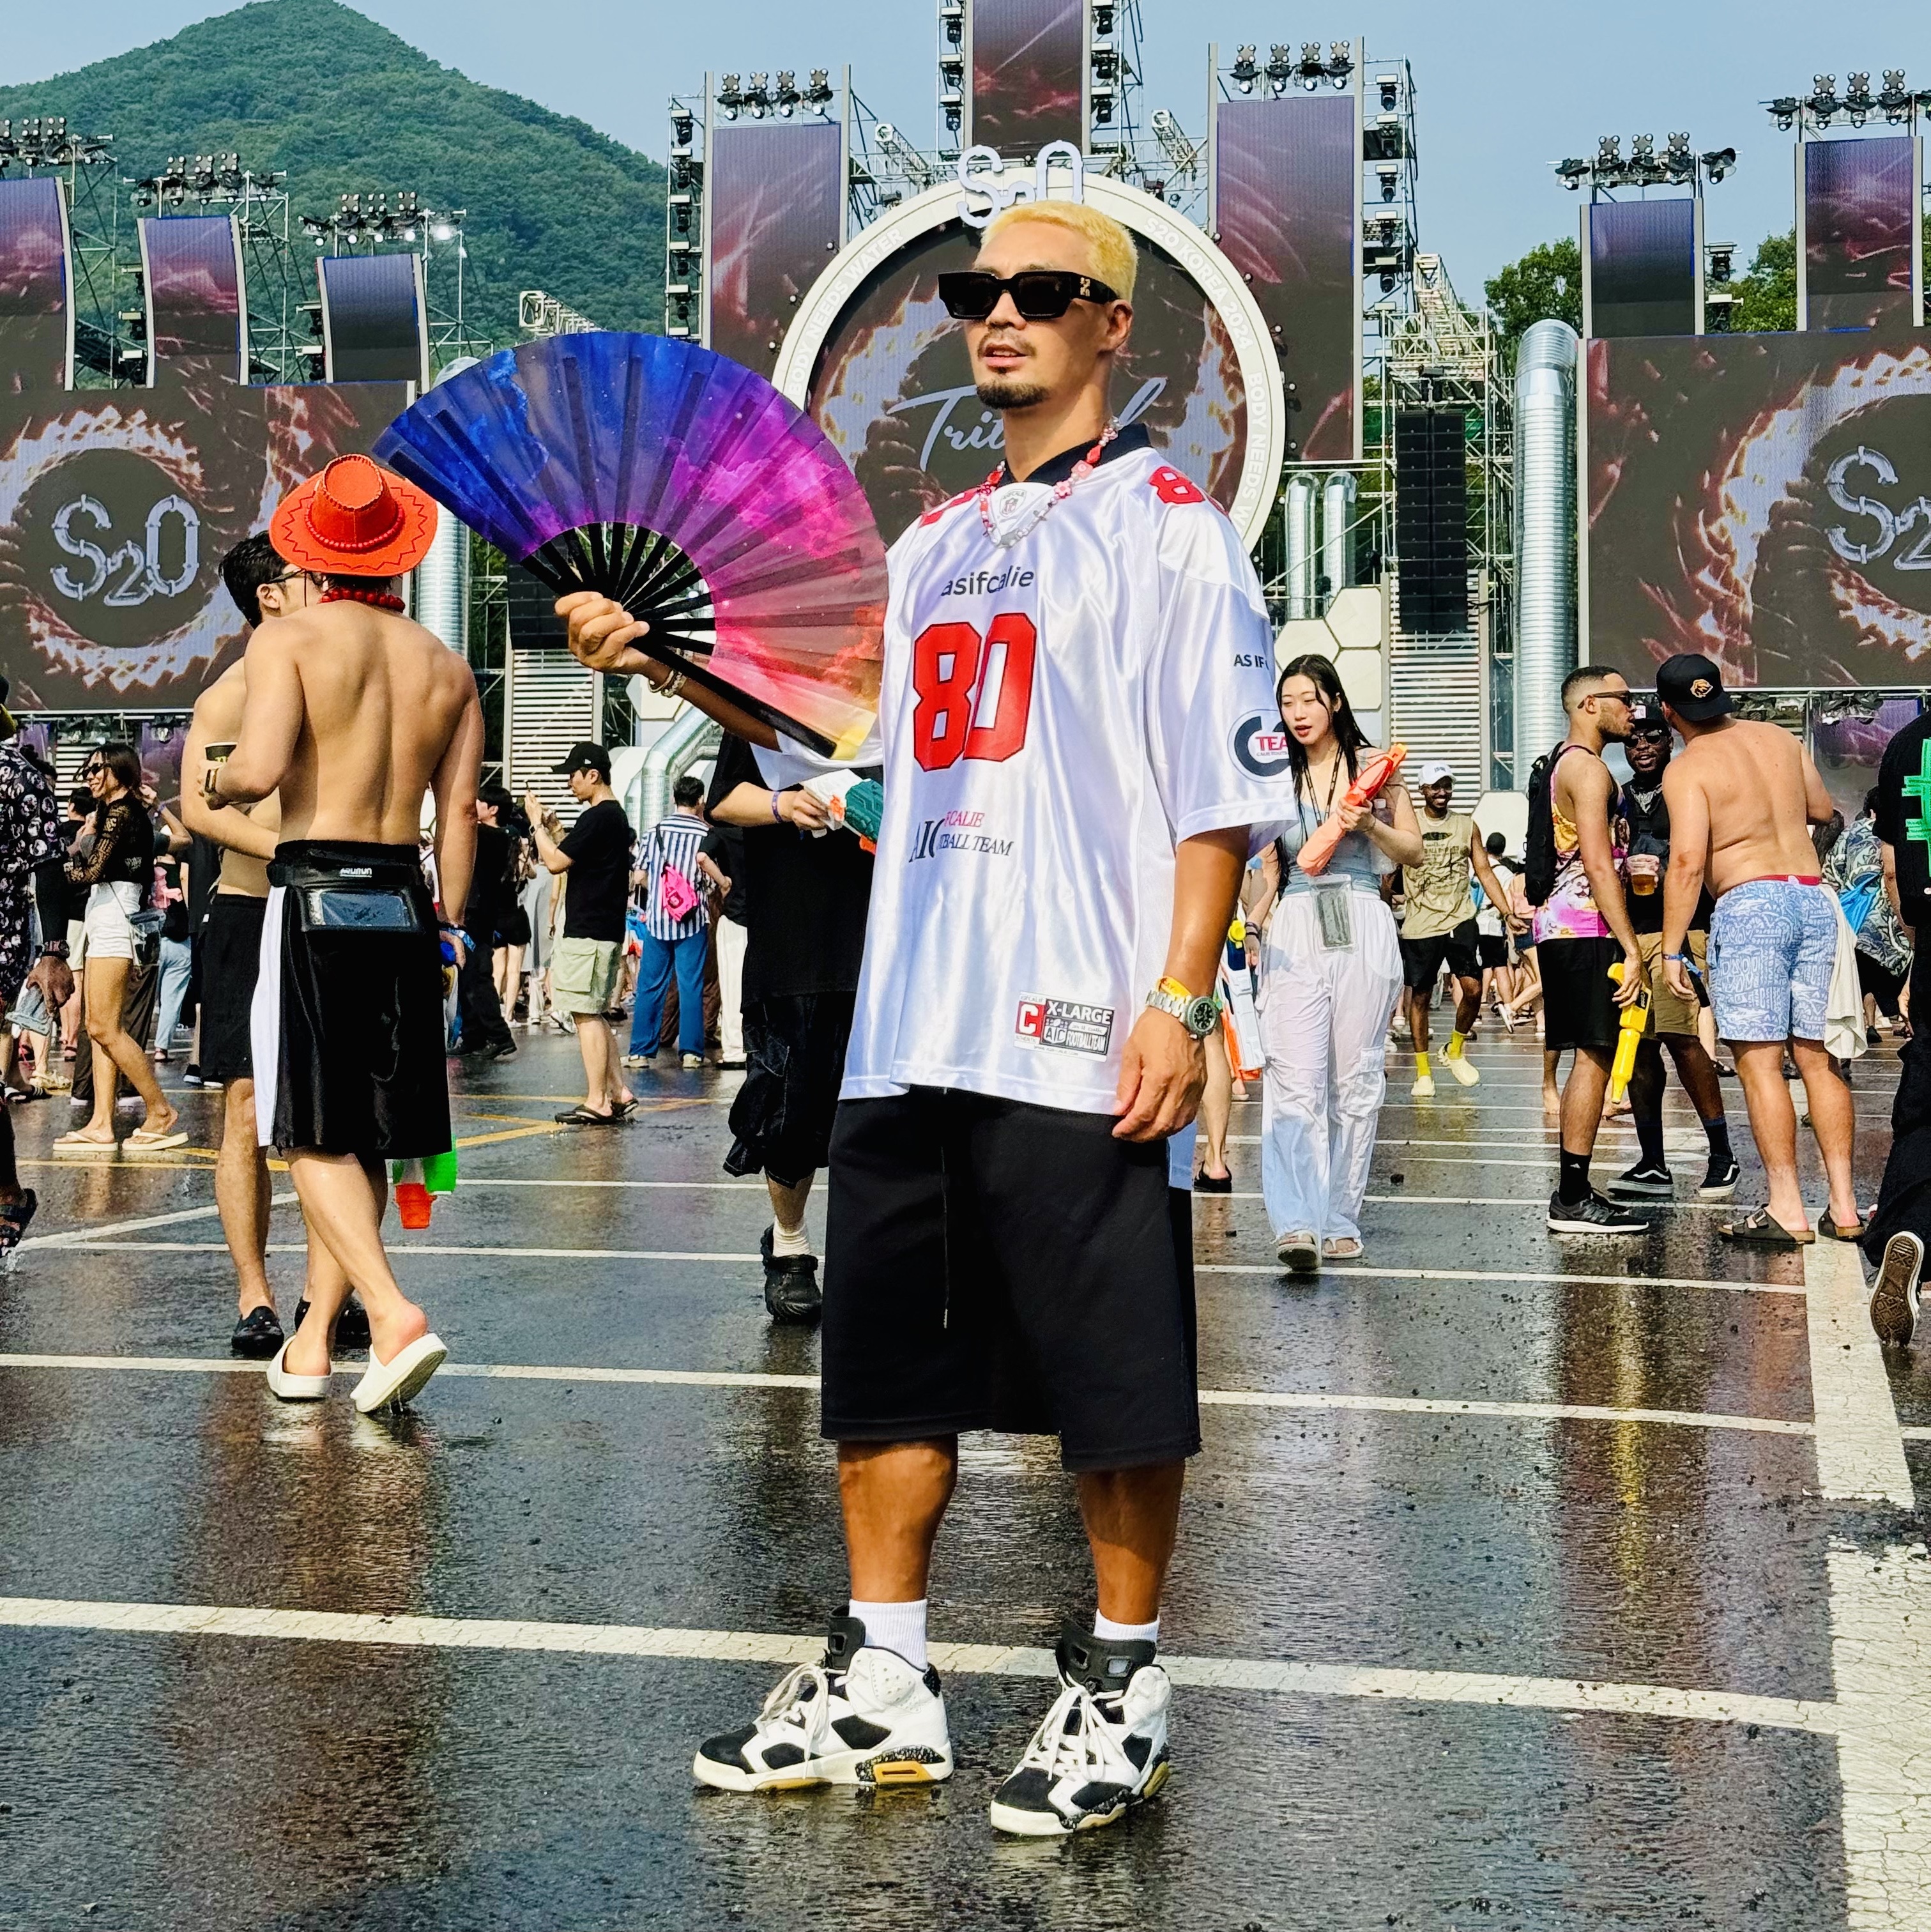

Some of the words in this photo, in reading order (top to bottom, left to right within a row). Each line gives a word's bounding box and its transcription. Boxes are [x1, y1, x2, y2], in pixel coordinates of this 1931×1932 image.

[788, 341, 810, 396] BODY
[805, 280, 850, 339] NEEDS
[844, 227, 904, 282] WATER
[1178, 243, 1229, 303] KOREA
[1222, 301, 1253, 350] 2024
[1248, 372, 1267, 428] BODY
[1242, 434, 1267, 500] NEEDS
[940, 565, 1034, 596] asifcalie
[913, 613, 1037, 772] 80
[971, 835, 1014, 856] TEAM
[1019, 1003, 1039, 1034] C
[1046, 1000, 1113, 1025] X-LARGE
